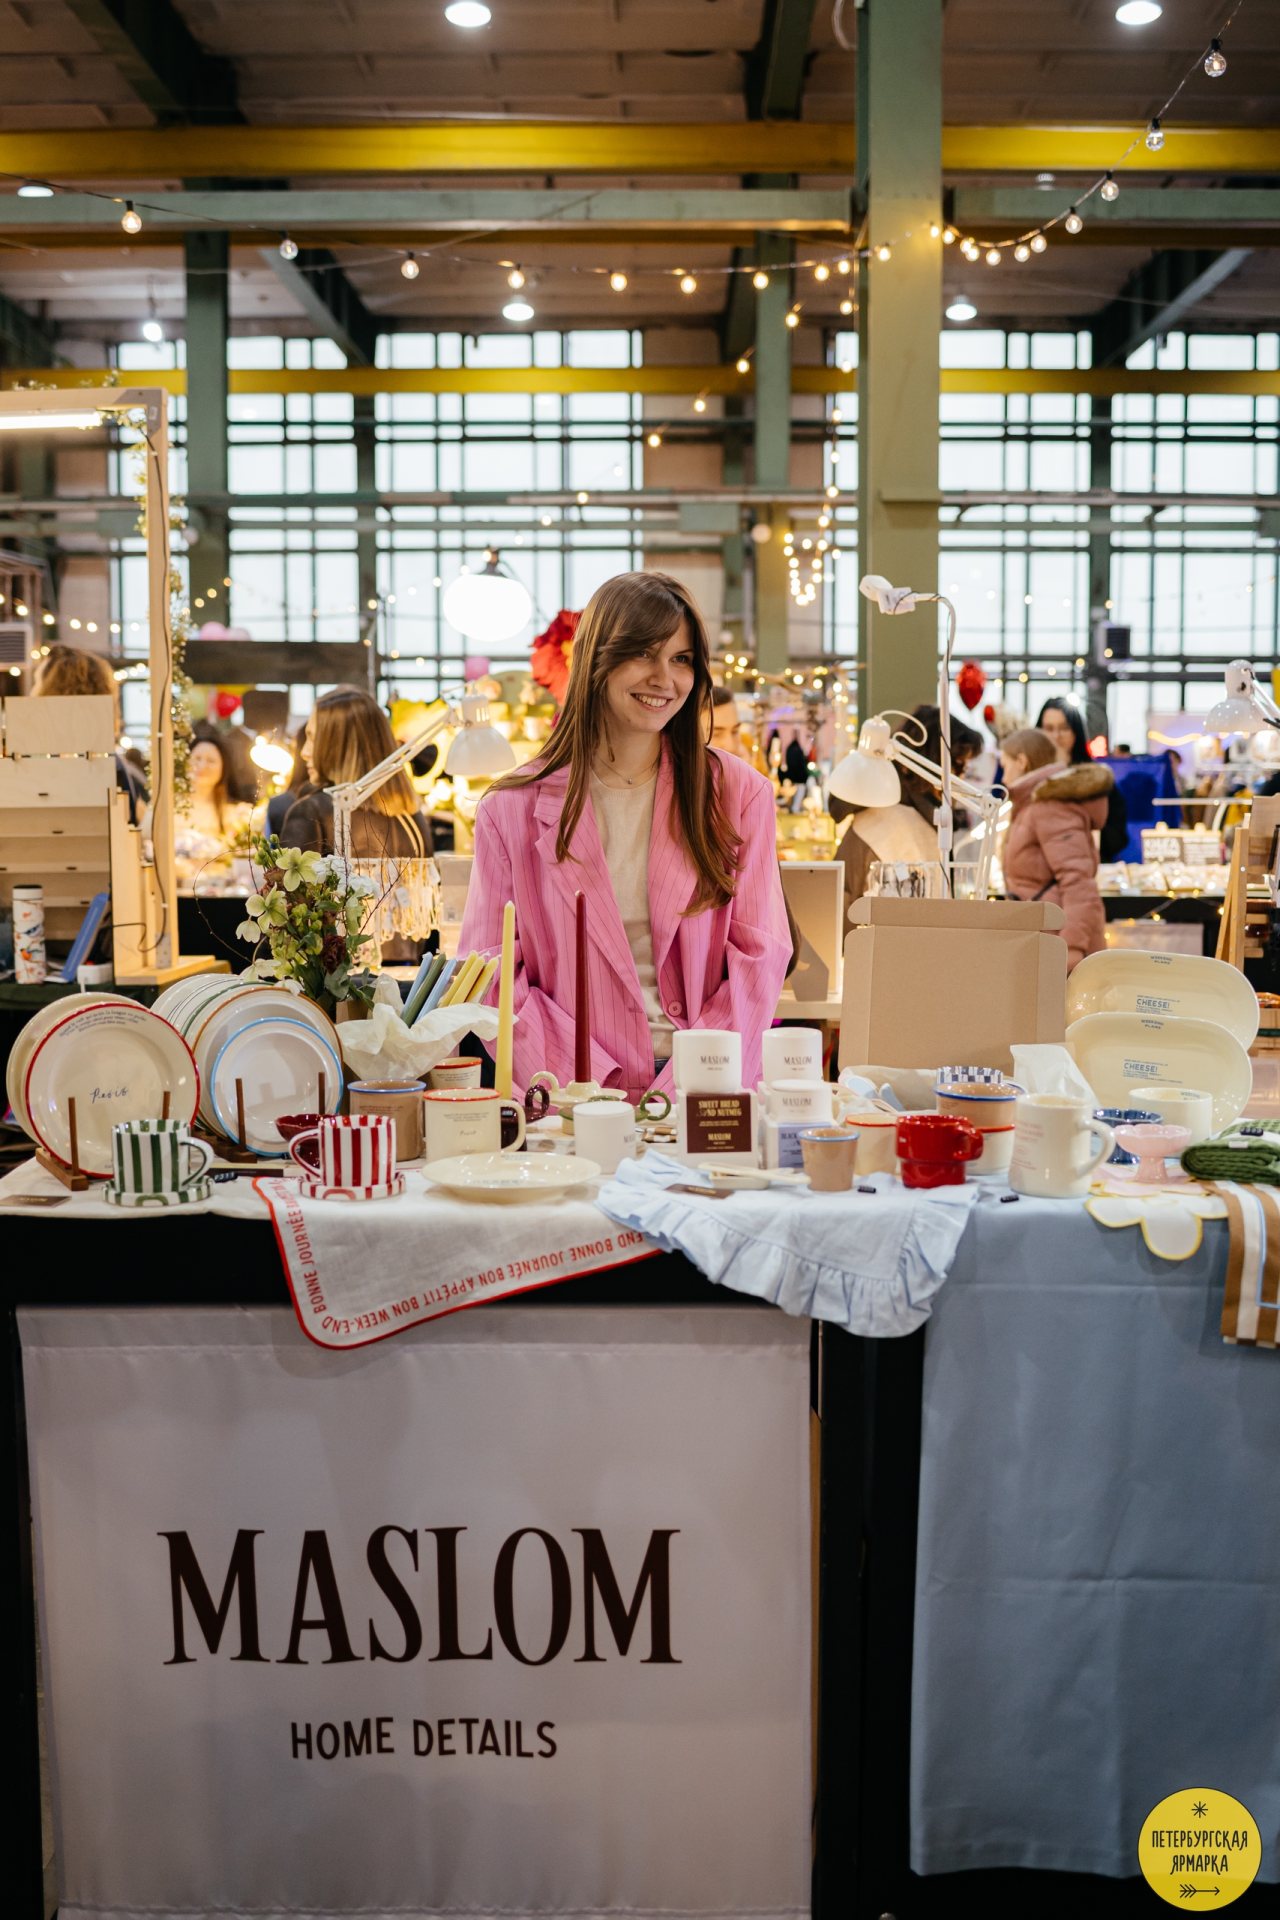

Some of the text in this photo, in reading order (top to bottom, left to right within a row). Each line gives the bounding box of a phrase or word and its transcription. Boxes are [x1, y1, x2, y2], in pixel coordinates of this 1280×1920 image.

[1136, 998, 1170, 1009] CHEESE!
[699, 1055, 730, 1065] MASLOM
[783, 1056, 812, 1065] MASLOM
[1123, 1062, 1158, 1073] CHEESE!
[699, 1099, 740, 1108] SWEET BREAD
[717, 1108, 742, 1117] NUTMEG
[782, 1097, 812, 1107] MASLOM
[707, 1132, 732, 1141] MASLOM
[286, 1209, 316, 1266] JOURNÉE
[569, 1237, 614, 1262] BONNE
[506, 1250, 565, 1280] JOURNÉE
[478, 1266, 505, 1287] BON
[303, 1270, 327, 1314] BONNE
[423, 1277, 475, 1307] APPÉTIT
[392, 1296, 420, 1318] BON
[321, 1308, 390, 1335] WEEK-END
[156, 1524, 683, 1666] MASLOM
[291, 1716, 558, 1760] HOME DETAILS
